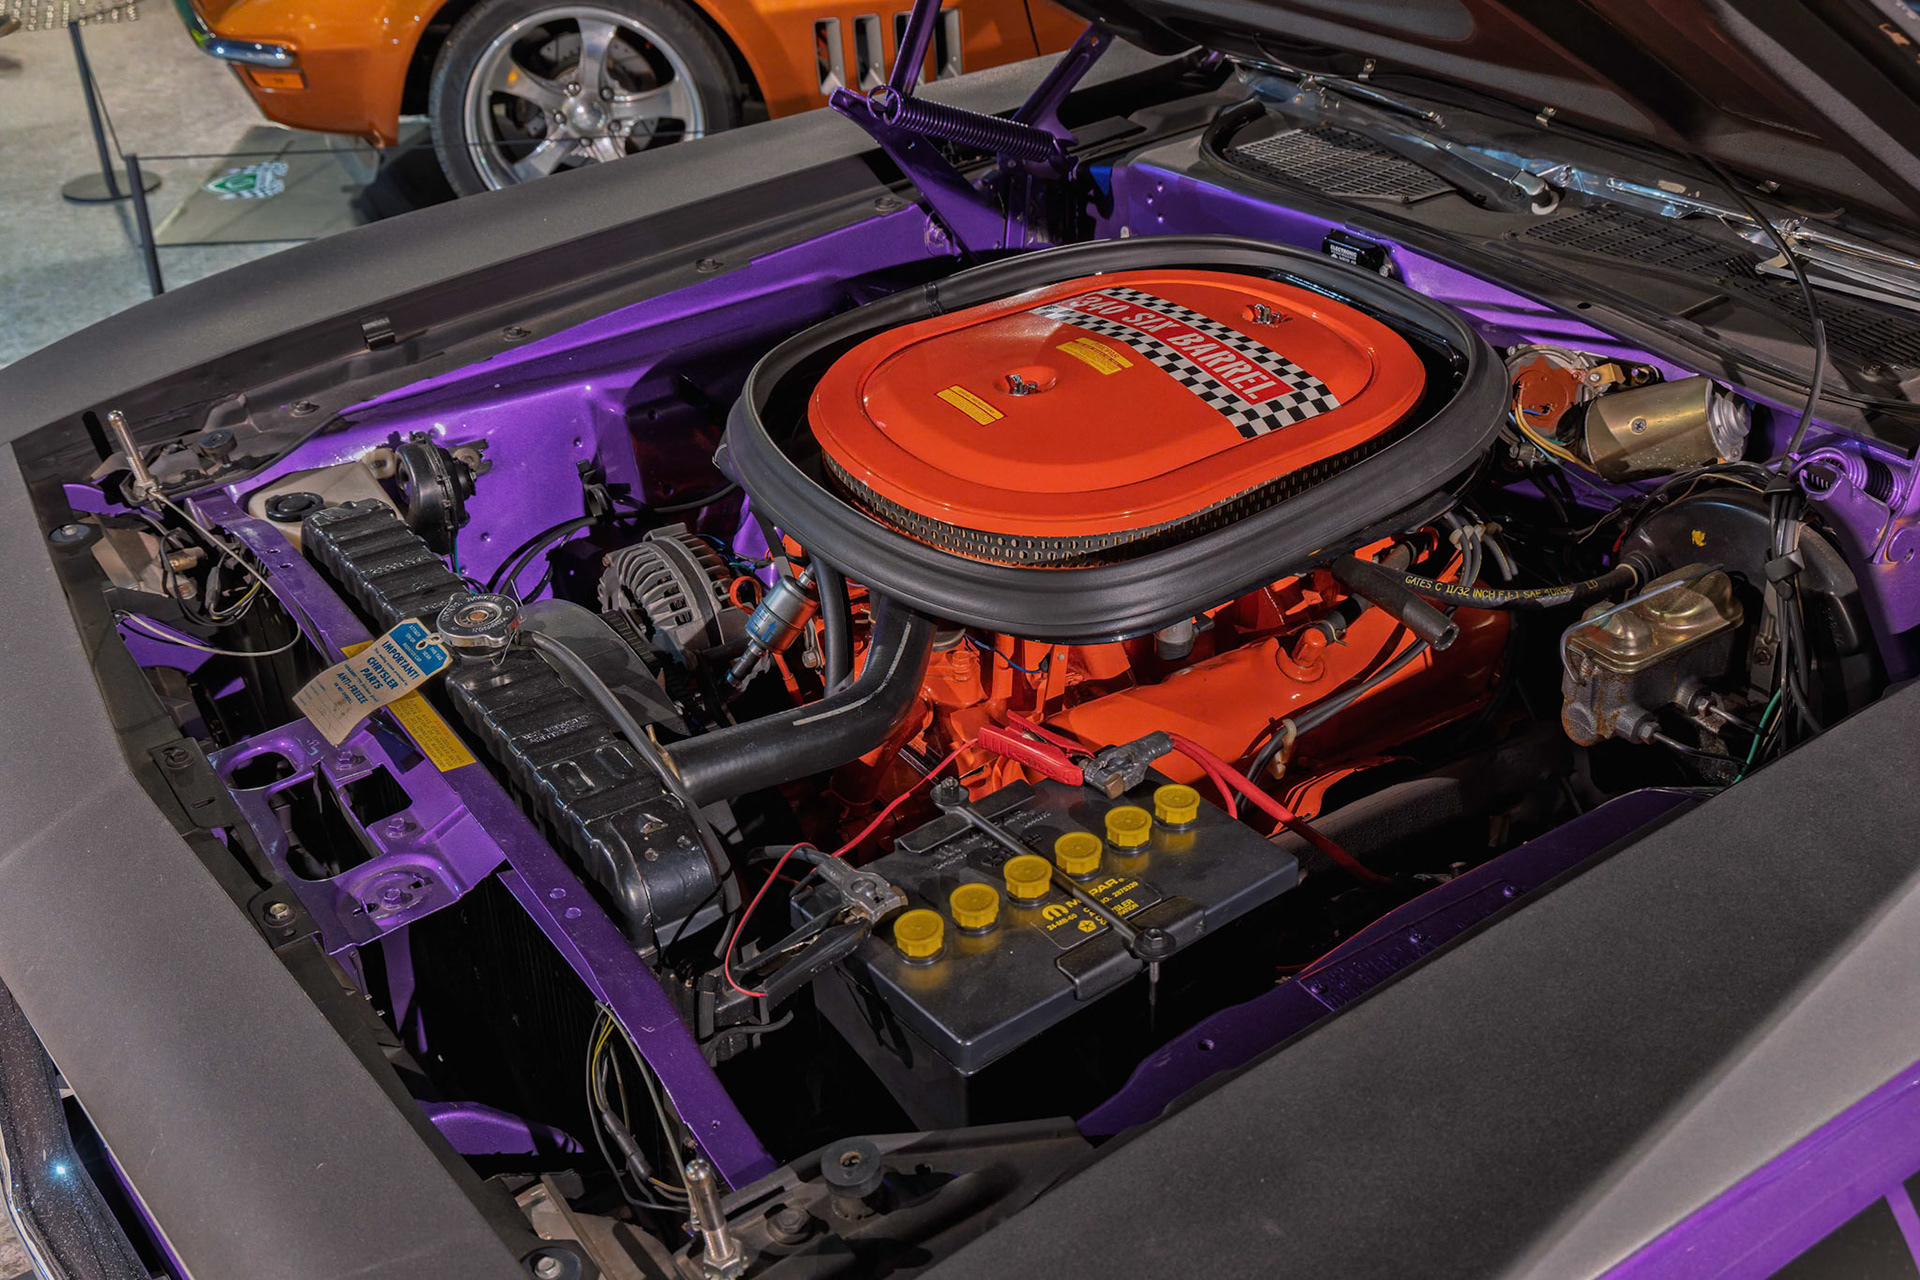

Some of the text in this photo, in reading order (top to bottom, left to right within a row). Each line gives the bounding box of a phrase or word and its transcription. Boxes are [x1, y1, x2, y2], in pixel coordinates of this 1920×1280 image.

[1069, 296, 1277, 401] 340 SIX BARREL
[1405, 575, 1432, 589] GATES
[1434, 583, 1443, 592] C
[1446, 584, 1470, 597] 11/32
[1472, 588, 1495, 599] INCH
[1523, 588, 1543, 599] SAE
[365, 656, 399, 689] CHRYSLER
[381, 640, 420, 680] IMPORTANT!
[337, 671, 369, 704] ANTI-FREEZE
[360, 667, 384, 690] PARTS
